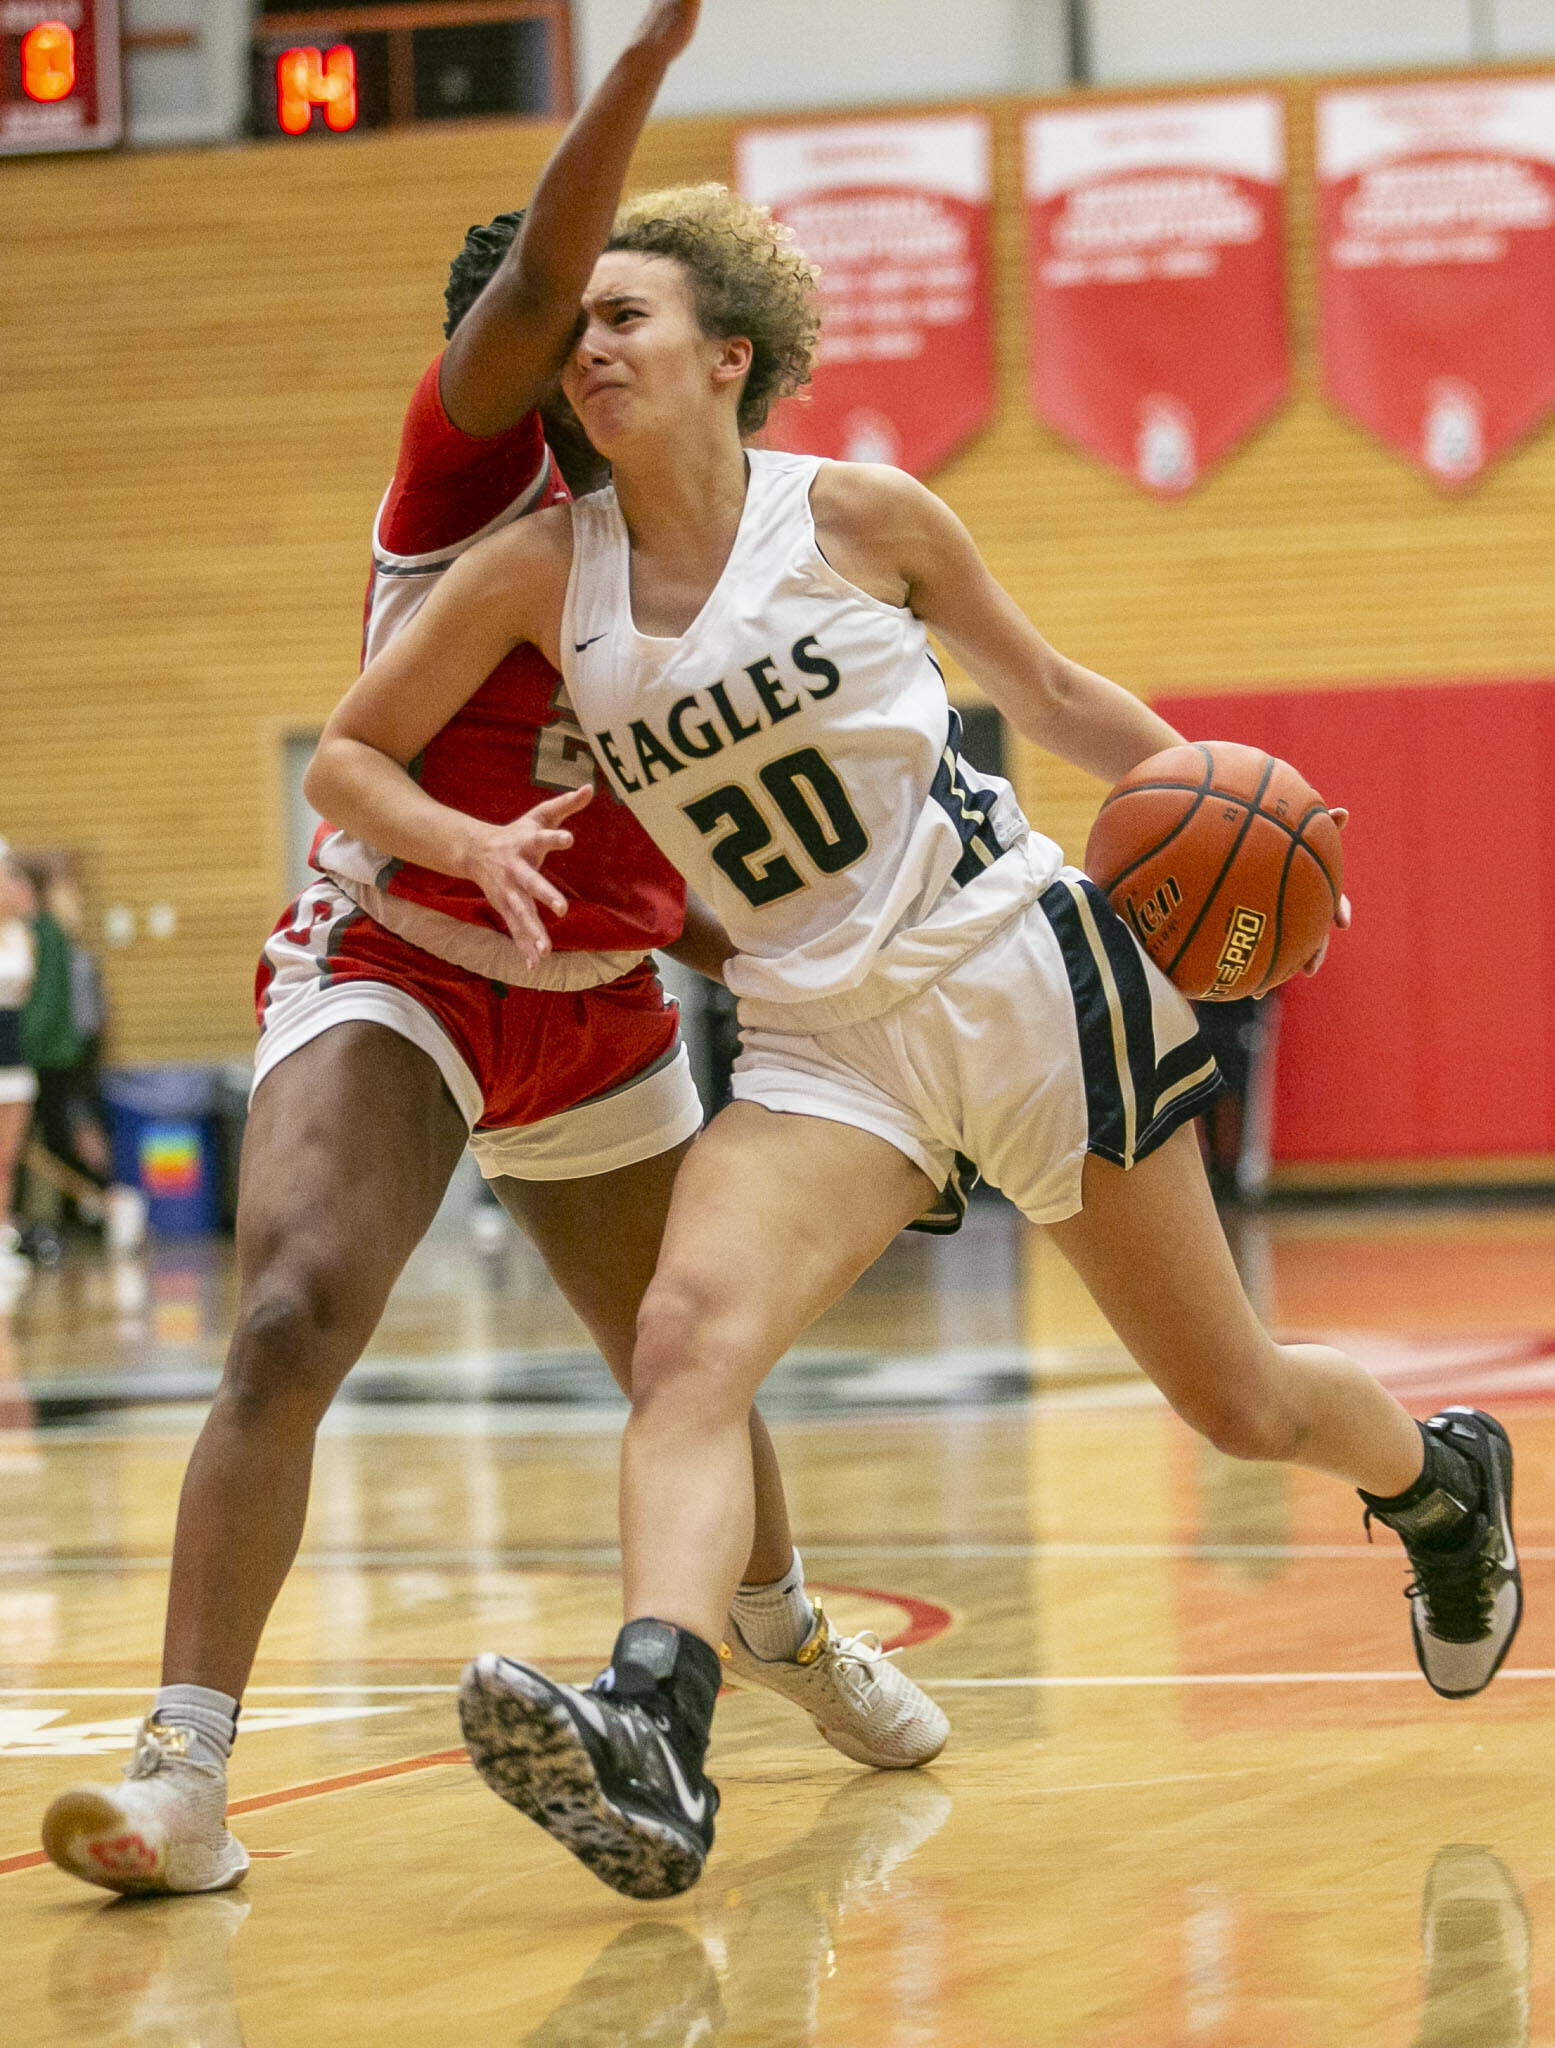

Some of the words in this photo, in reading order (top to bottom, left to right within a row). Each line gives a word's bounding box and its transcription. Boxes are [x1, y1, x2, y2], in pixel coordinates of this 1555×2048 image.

[595, 635, 841, 794] EAGLES
[679, 744, 872, 909] 20
[1223, 807, 1239, 822] 22
